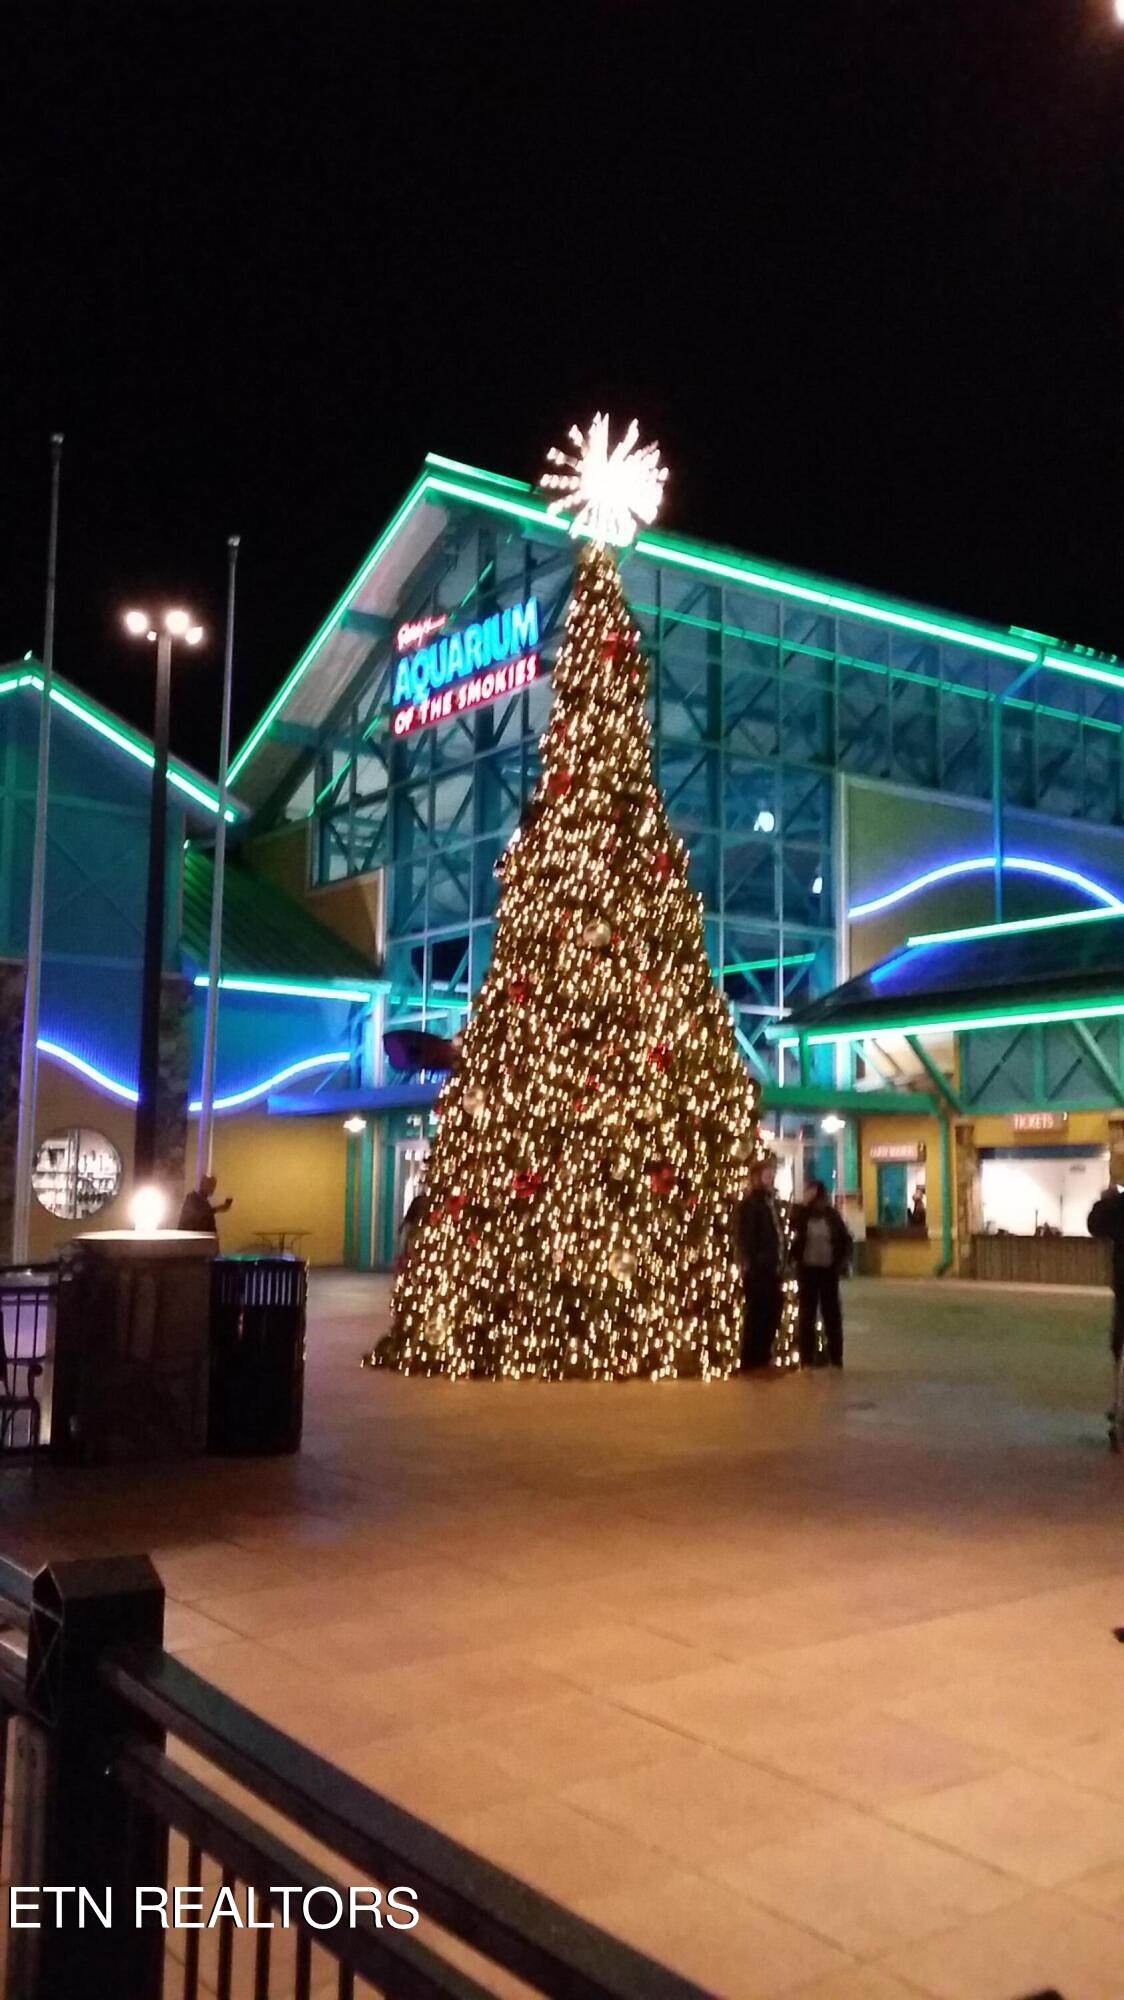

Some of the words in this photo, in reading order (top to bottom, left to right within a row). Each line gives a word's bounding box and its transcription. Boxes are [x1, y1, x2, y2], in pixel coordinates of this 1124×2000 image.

[392, 595, 539, 706] AQUARIUM
[394, 706, 414, 735] OF
[419, 690, 453, 725] THE
[458, 654, 537, 709] SMOKIES
[1014, 1112, 1054, 1130] TICKETS
